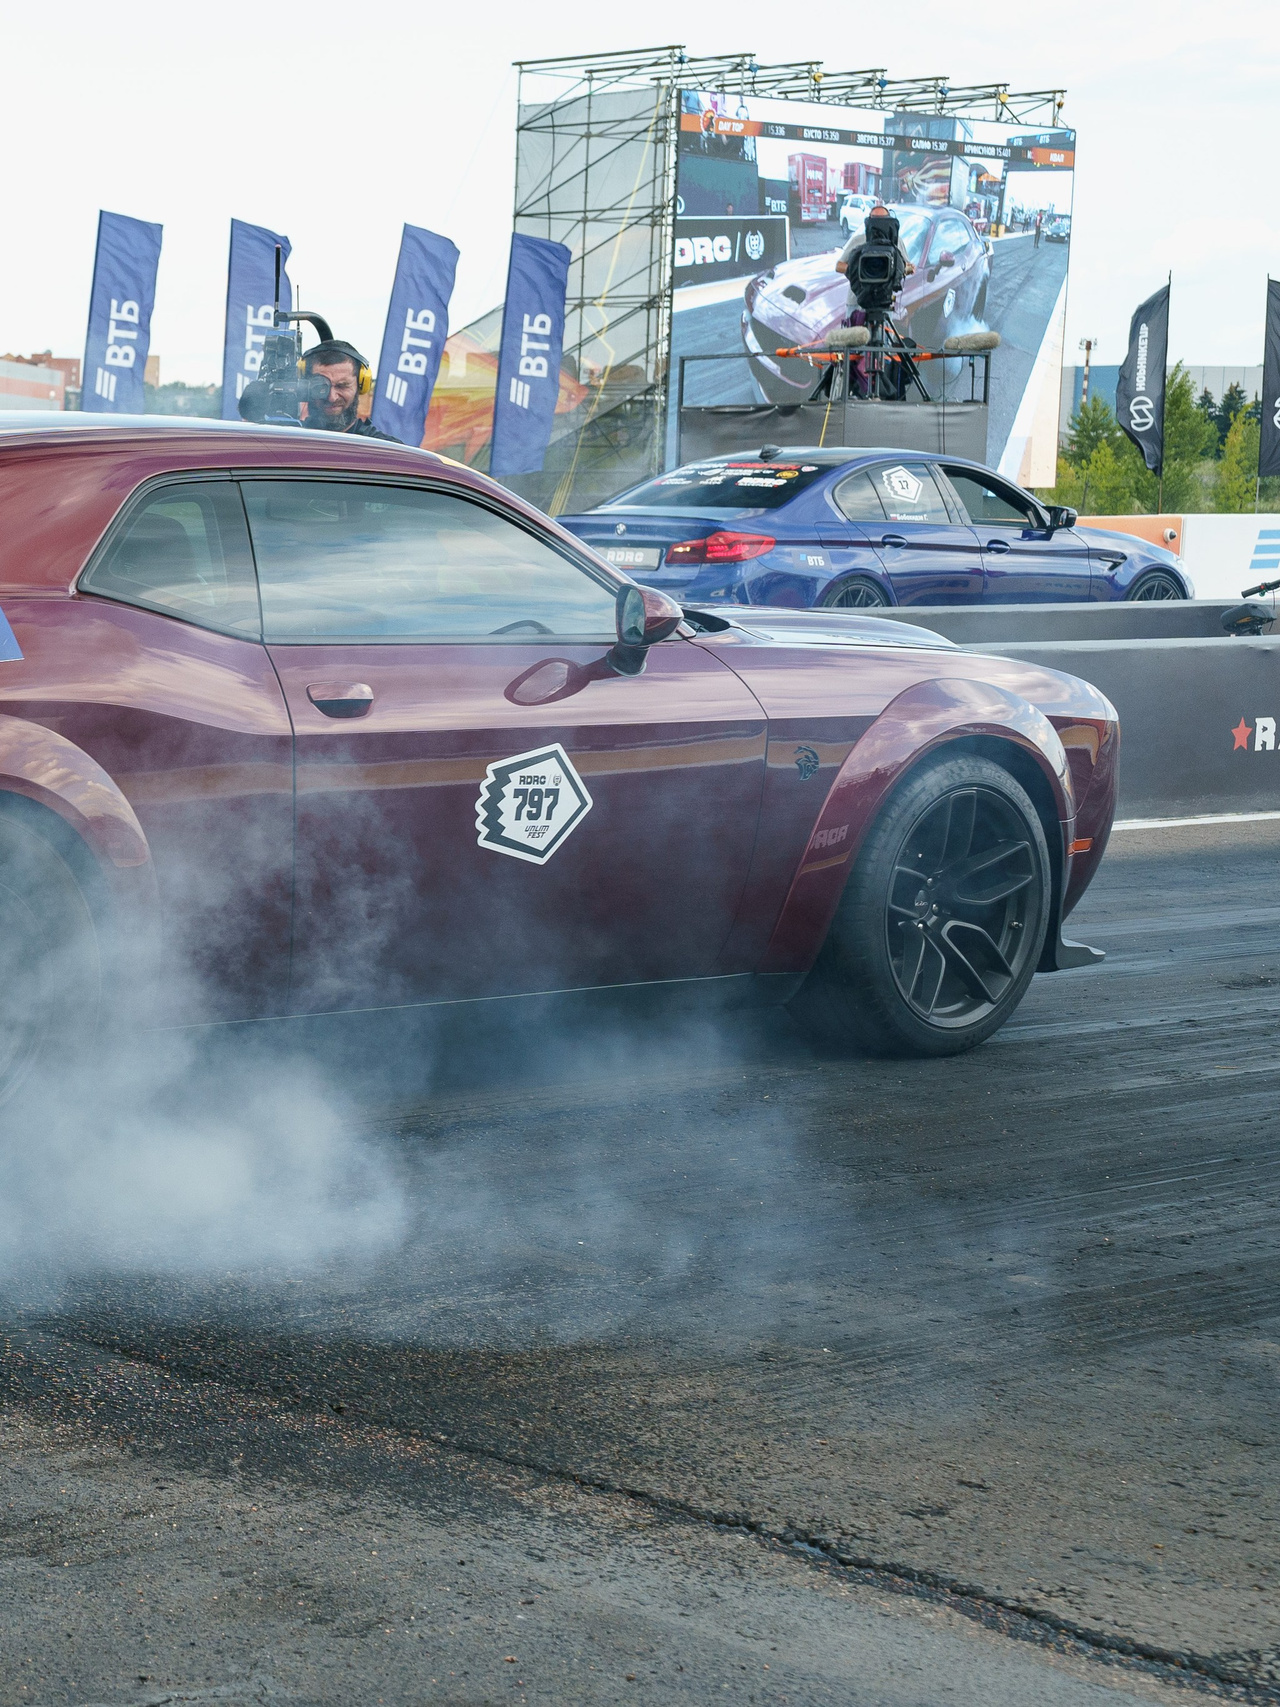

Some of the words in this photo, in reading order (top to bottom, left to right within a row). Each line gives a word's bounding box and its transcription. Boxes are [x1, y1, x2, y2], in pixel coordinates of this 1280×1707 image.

[674, 235, 732, 267] DRC
[105, 298, 139, 369] ВТБ
[398, 307, 436, 377] ВТБ
[518, 312, 552, 379] ВТБ
[898, 480, 909, 490] 17
[607, 550, 644, 563] RDRC
[807, 556, 825, 566] ВТБ
[519, 775, 547, 785] RDRC
[513, 788, 560, 821] 797
